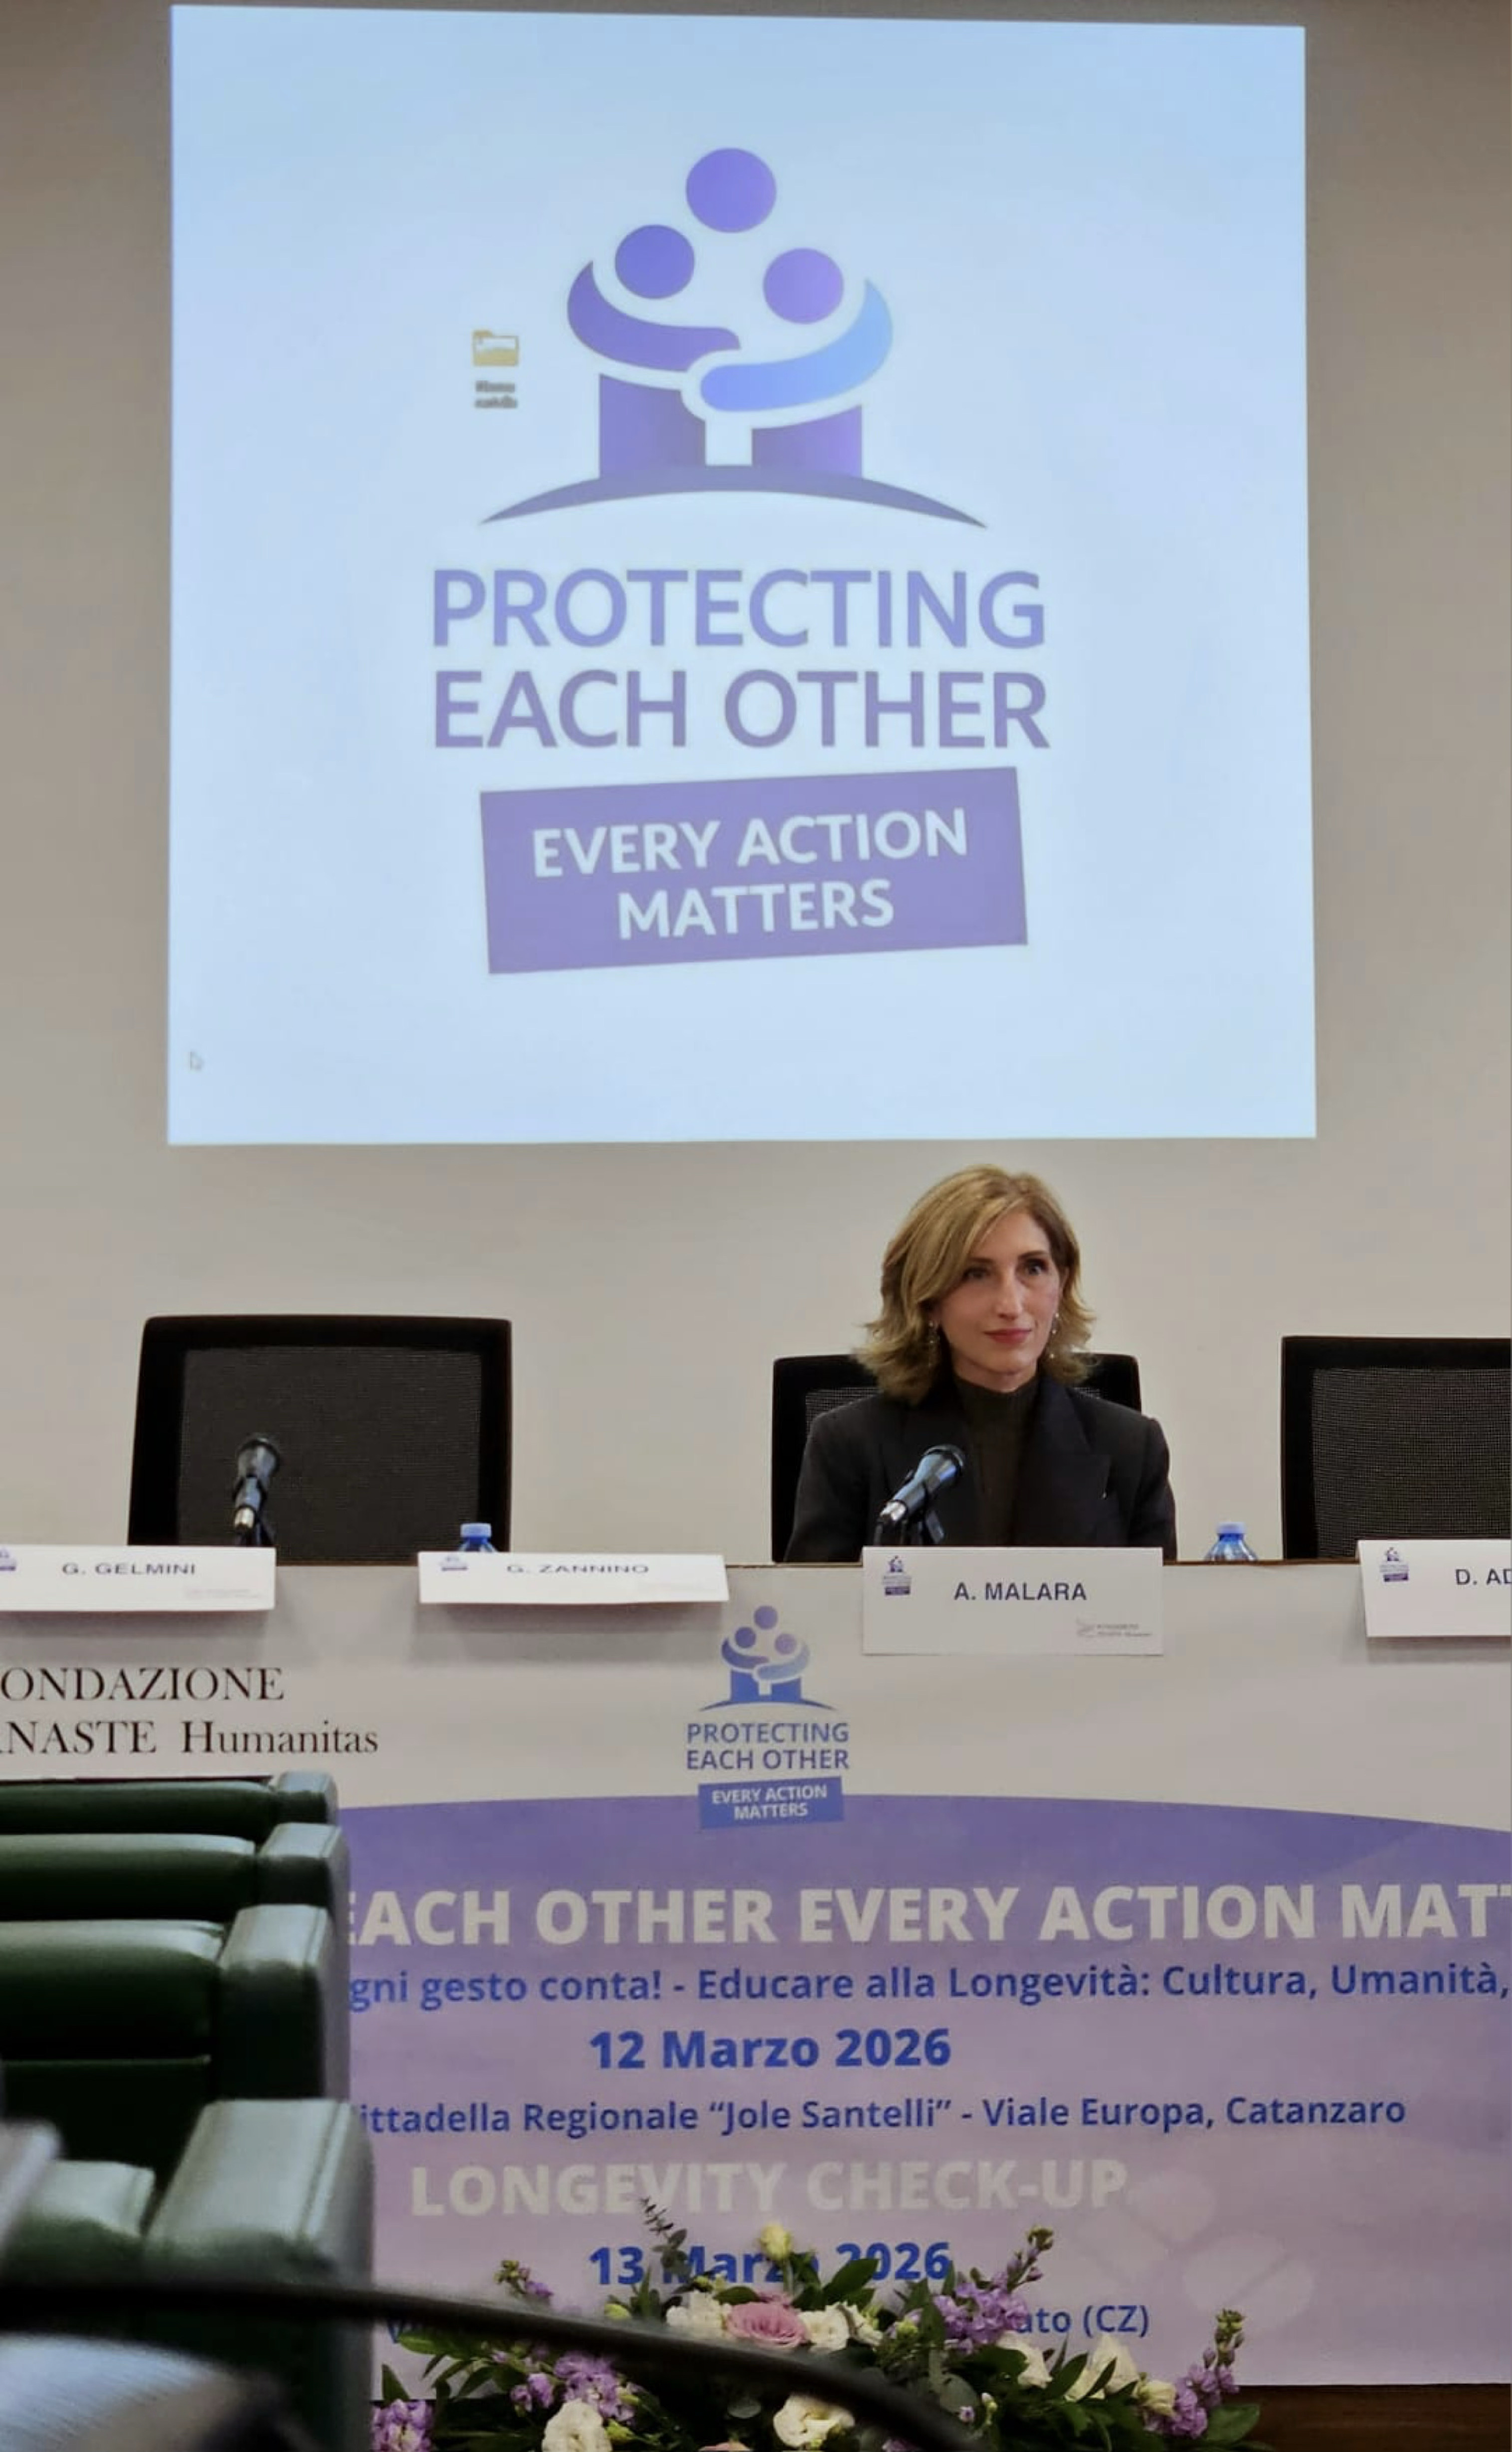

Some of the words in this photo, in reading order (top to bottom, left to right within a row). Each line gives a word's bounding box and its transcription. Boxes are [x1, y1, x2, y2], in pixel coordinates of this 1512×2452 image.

[432, 568, 1045, 649] PROTECTING
[434, 669, 687, 748] EACH
[724, 669, 1050, 748] OTHER
[533, 820, 720, 878] EVERY
[737, 807, 967, 868] ACTION
[617, 879, 894, 940] MATTERS
[62, 1563, 86, 1574] G.
[95, 1563, 196, 1574] GELMINI
[540, 1564, 649, 1574] ZANNINO
[1456, 1569, 1477, 1585] D.
[954, 1583, 975, 1600] A.
[985, 1583, 1087, 1600] MALARA
[0, 1721, 156, 1754] NASTE
[181, 1720, 378, 1754] Humanitas
[687, 1723, 849, 1743] PROTECTING
[687, 1750, 753, 1770] EACH
[762, 1750, 850, 1769] OTHER
[712, 1790, 761, 1804] EVERY
[765, 1785, 827, 1801] ACTION
[734, 1803, 808, 1820] MATTERS
[348, 1891, 510, 1945] ACH
[536, 1889, 777, 1944] OTHER
[800, 1888, 1019, 1943] EVERY
[1039, 1885, 1315, 1941] ACTION
[1342, 1884, 1512, 1938] MAT
[421, 1974, 527, 2011] gesto
[540, 1970, 661, 2001] conta!
[700, 1969, 854, 2000] Educare
[866, 1967, 934, 1998] alla
[950, 1965, 1150, 2006] Longevità:
[1164, 1964, 1317, 1999] Cultura,
[1332, 1962, 1509, 1999] Umanità,
[590, 2032, 644, 2069] 12
[663, 2031, 819, 2069] Marzo
[835, 2028, 951, 2067] 2026
[351, 2102, 510, 2133] ittadella
[524, 2100, 698, 2139] Regionale
[983, 2098, 1069, 2127] Viale
[1082, 2097, 1213, 2133] Europa,
[1226, 2098, 1405, 2124] Catanzaro
[411, 2162, 787, 2216] LONGEVITY
[807, 2159, 1127, 2210] CHECK-UP
[590, 2247, 644, 2285] 13
[1083, 2305, 1149, 2338] (CZ)
